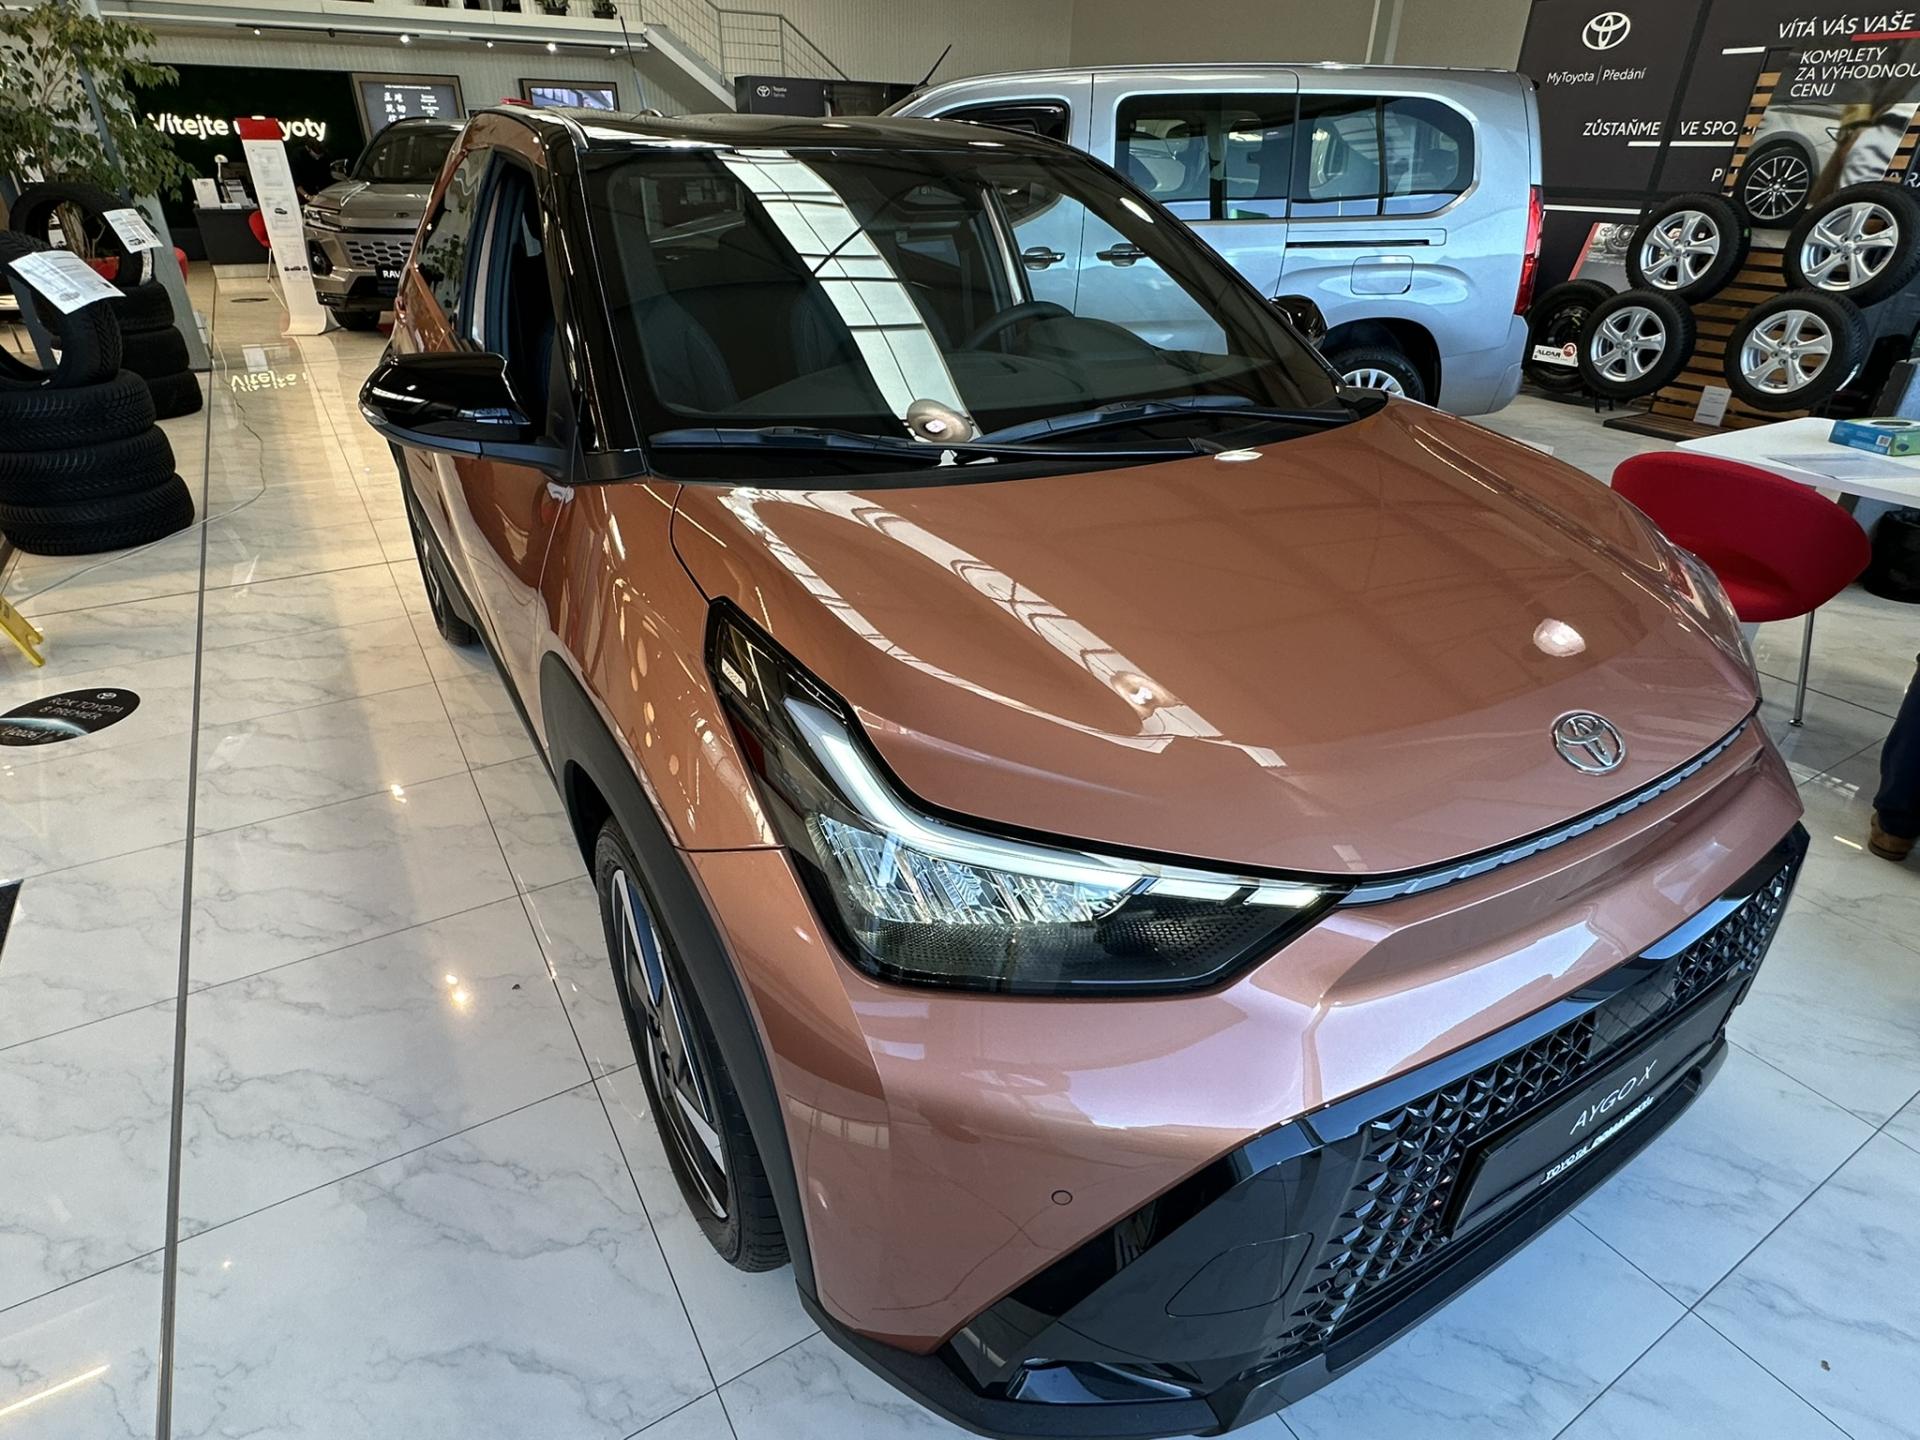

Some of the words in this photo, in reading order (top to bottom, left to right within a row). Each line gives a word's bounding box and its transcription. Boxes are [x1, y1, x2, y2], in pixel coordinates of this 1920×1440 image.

[1779, 16, 1817, 39] VÍTÁ
[1822, 14, 1859, 36] VÁS
[1864, 10, 1916, 33] VAŠE
[1800, 46, 1888, 65] KOMPLETY
[1546, 71, 1595, 86] MyToyota
[1602, 67, 1648, 81] Předání
[1794, 67, 1816, 81] ZA
[1790, 83, 1836, 97] CENU
[147, 112, 230, 141] Vítejte
[1679, 121, 1701, 136] VE
[382, 270, 401, 279] RAV
[77, 700, 124, 714] TOYOTA
[1570, 1077, 1637, 1135] AYGO
[1637, 1059, 1658, 1087] X
